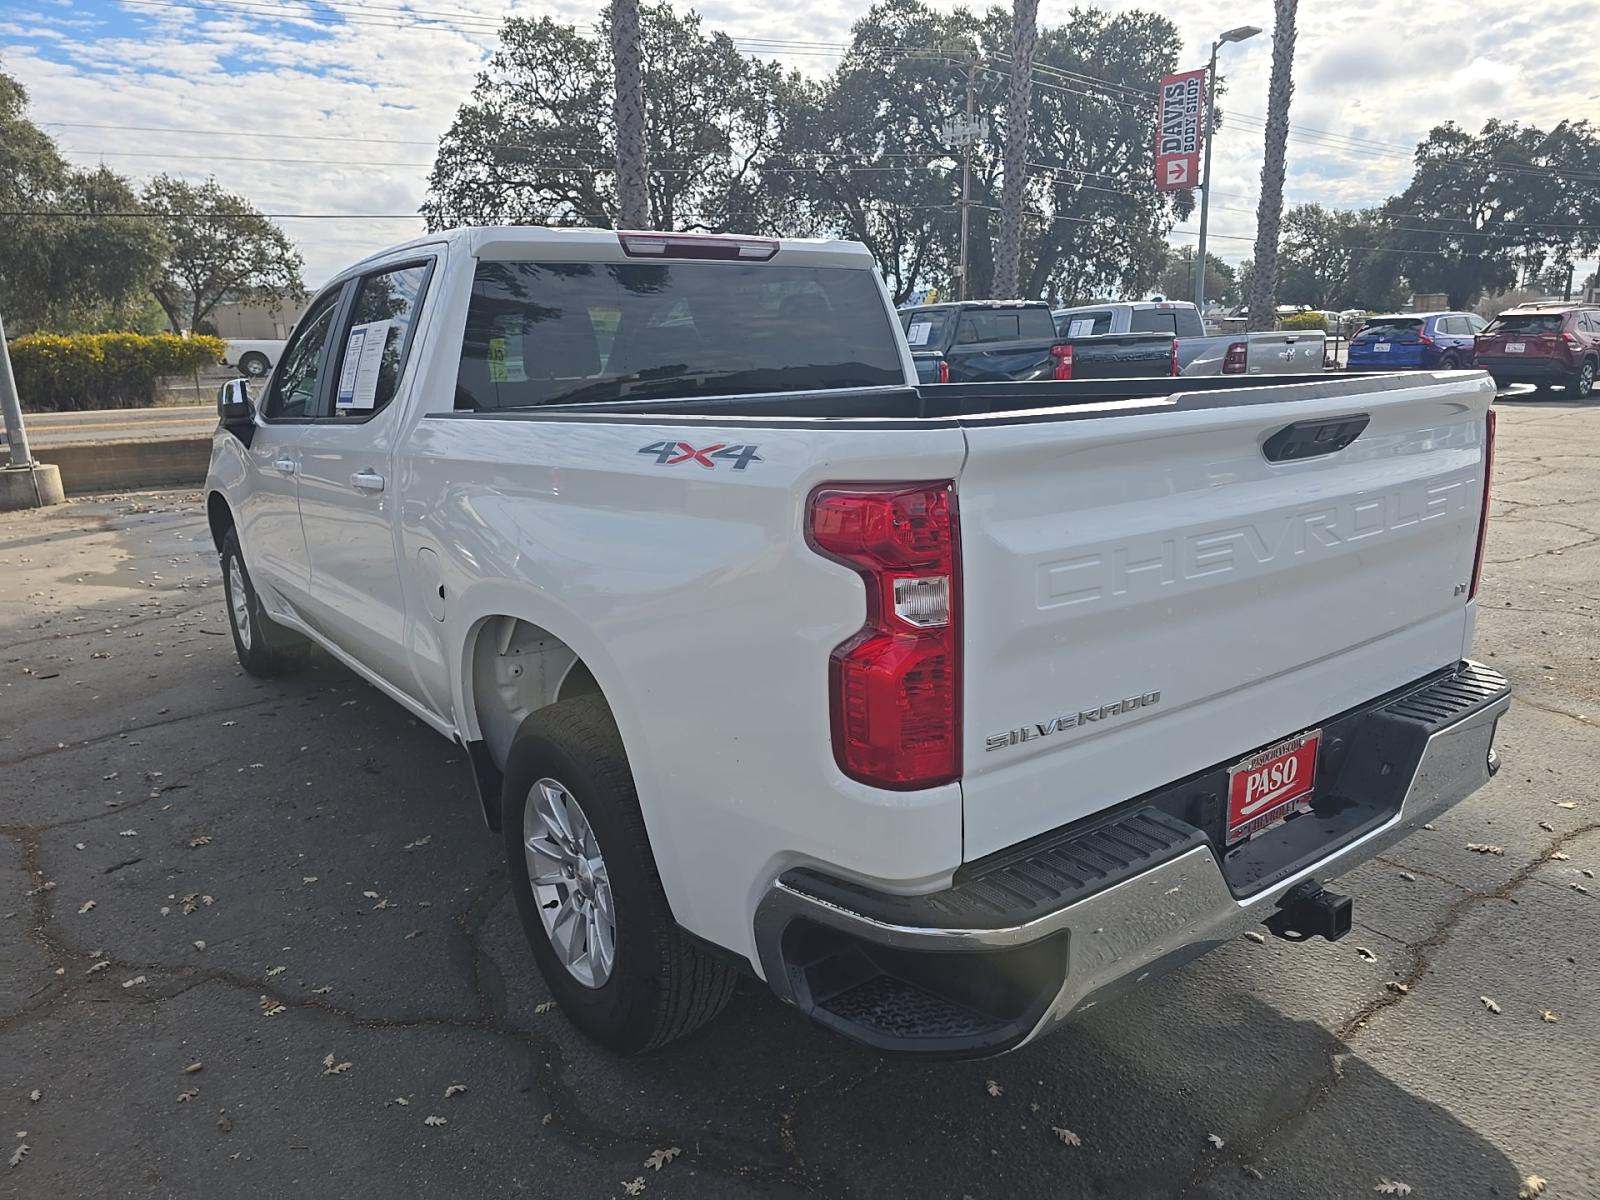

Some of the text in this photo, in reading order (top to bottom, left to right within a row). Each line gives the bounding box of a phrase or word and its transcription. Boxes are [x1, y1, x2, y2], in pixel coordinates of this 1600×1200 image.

[1162, 82, 1186, 153] DAVIS
[1184, 79, 1199, 153] BODY SHOP
[1035, 476, 1477, 610] CHEVROLET
[985, 690, 1161, 752] SILVERADO
[1246, 756, 1298, 804] PASO
